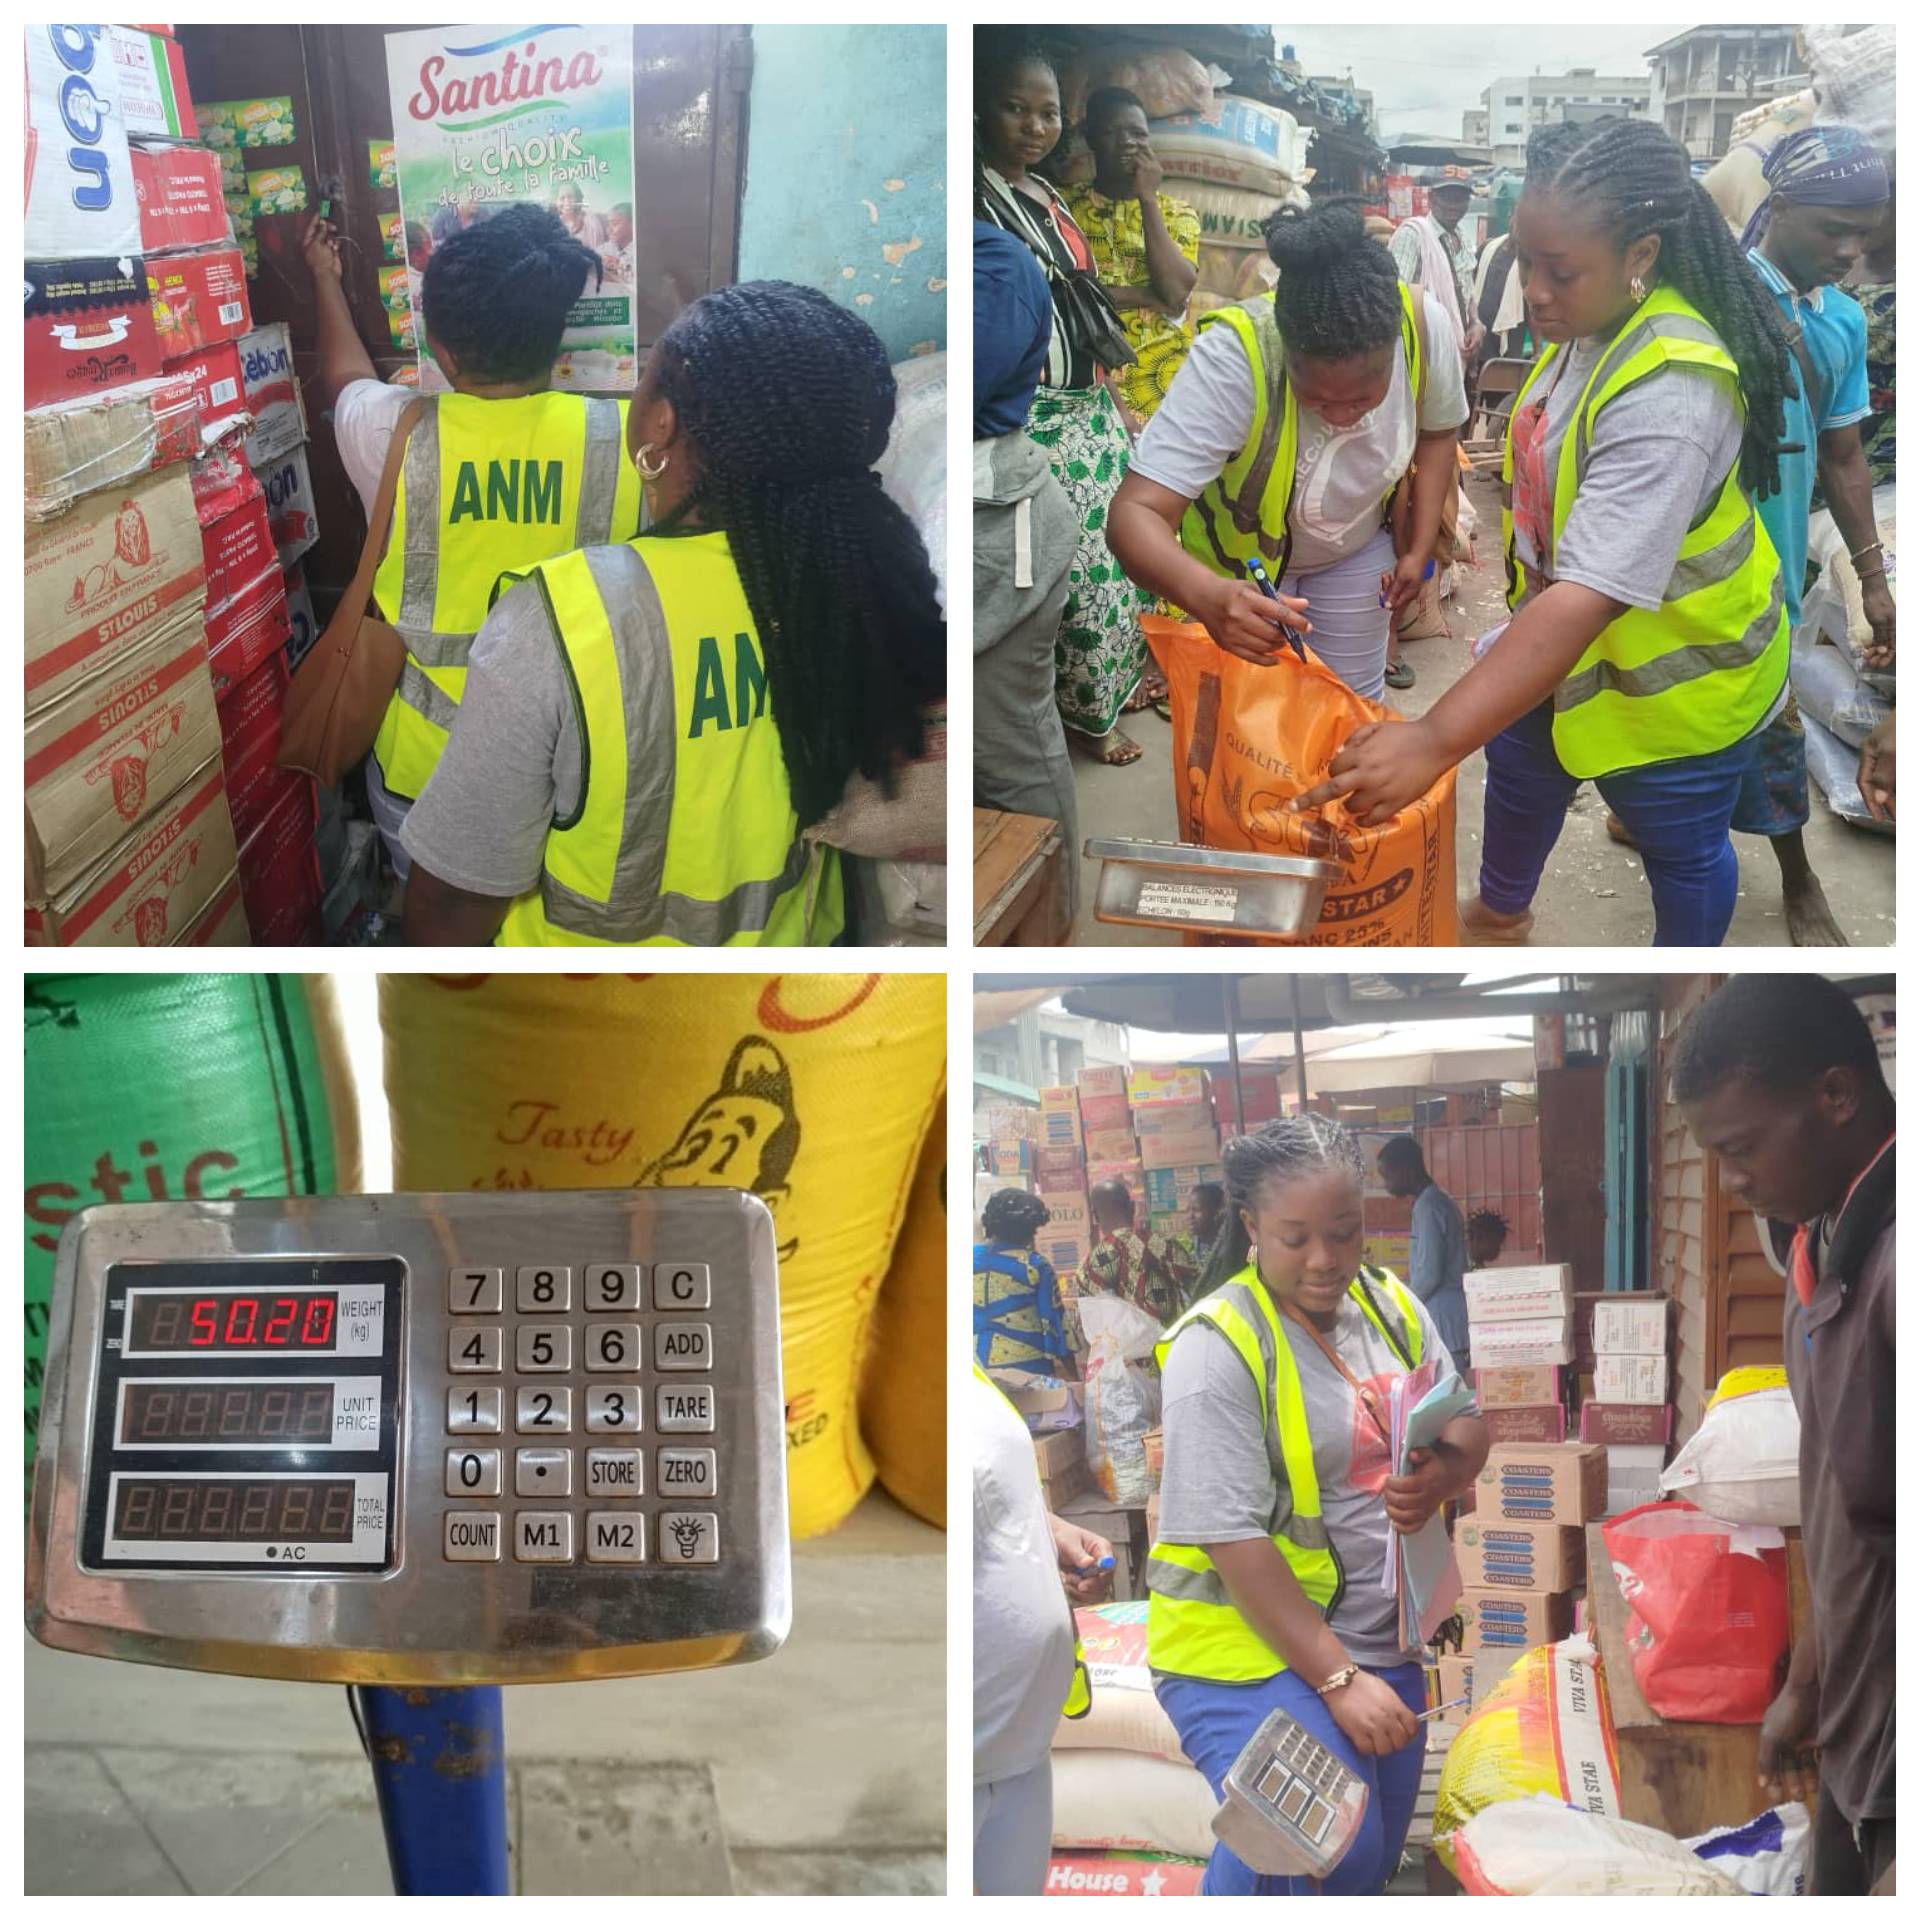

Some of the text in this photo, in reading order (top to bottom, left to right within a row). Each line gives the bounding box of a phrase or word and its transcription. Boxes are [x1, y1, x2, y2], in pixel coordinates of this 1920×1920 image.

[408, 41, 603, 121] Santina
[452, 126, 583, 180] le choix
[438, 155, 610, 208] de toute la famille
[448, 458, 563, 525] ANM
[1226, 732, 1294, 779] QUALITÉ
[1322, 888, 1387, 918] STAR
[1345, 918, 1385, 942] 25%
[495, 1100, 638, 1166] Tasty
[465, 1270, 694, 1305] 7 8 9 C
[341, 1300, 383, 1317] WEIGHT
[191, 1299, 335, 1345] 50.20
[351, 1322, 370, 1343] (kg)
[462, 1331, 704, 1364] 4 5 6 ADD
[343, 1397, 375, 1412] UNIT
[465, 1391, 707, 1425] 1 2 3 TARE
[336, 1415, 377, 1431] PRICE
[460, 1454, 482, 1487] 0
[592, 1461, 635, 1484] STORE
[665, 1460, 706, 1483] ZERO
[1503, 1466, 1551, 1476] COASTERS
[1504, 1487, 1552, 1498] COASTERS
[358, 1498, 385, 1513] TOTAL
[1504, 1509, 1553, 1519] COASTERS
[357, 1515, 384, 1530] PRICE
[450, 1523, 634, 1547] COUNT M1 M2
[1484, 1531, 1533, 1542] COASTERS
[282, 1547, 306, 1560] AC
[1484, 1553, 1533, 1564] COASTERS
[1485, 1574, 1534, 1585] COASTERS
[1480, 1601, 1526, 1612] COASTERS
[1481, 1623, 1527, 1634] COASTERS
[1573, 1688, 1586, 1714] VIVA
[1588, 1792, 1606, 1816] IVA
[1048, 1866, 1129, 1892] House
